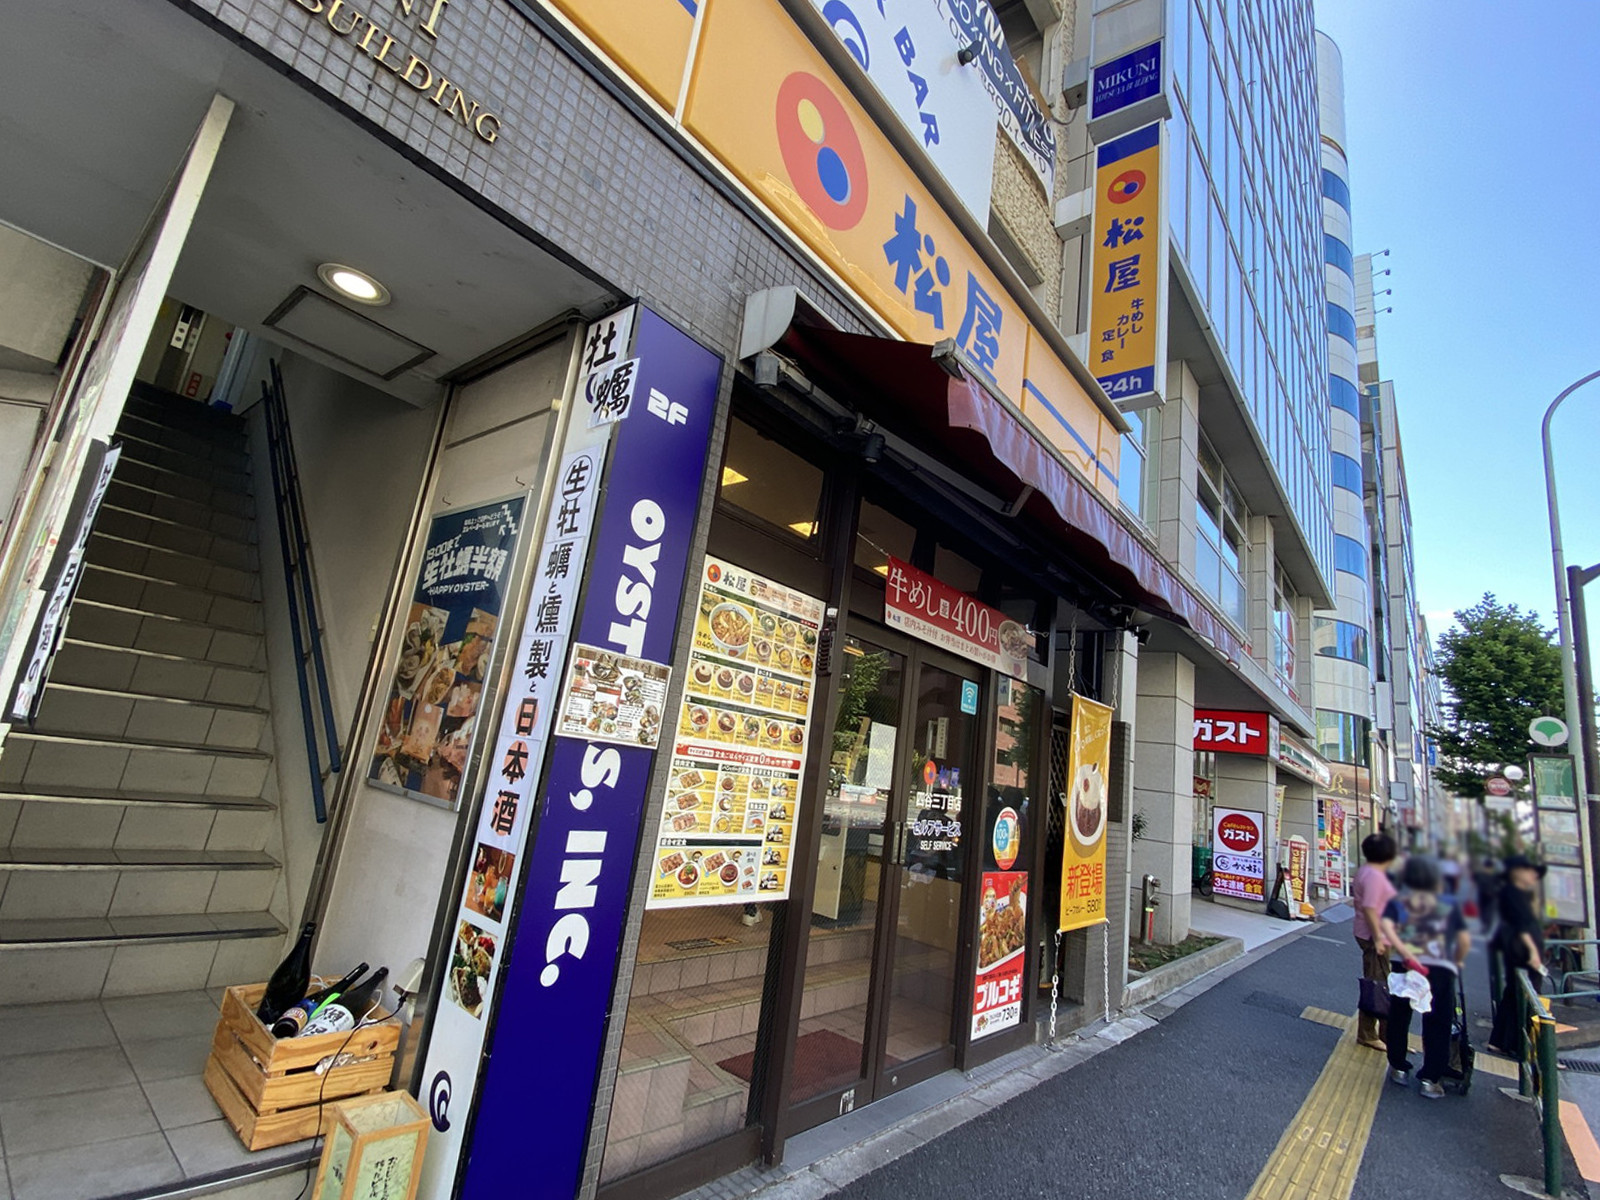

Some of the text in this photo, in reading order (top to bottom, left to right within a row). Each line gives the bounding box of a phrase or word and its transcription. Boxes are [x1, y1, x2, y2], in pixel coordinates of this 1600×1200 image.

[894, 25, 940, 148] BAR
[1097, 57, 1157, 93] MIKUNI
[1103, 216, 1145, 293] 松屋
[882, 193, 1003, 386] 松屋
[1116, 314, 1130, 349] カレー
[1130, 298, 1144, 334] 牛めし
[1101, 375, 1142, 395] 24h
[647, 387, 689, 425] 2F
[722, 571, 748, 594] 松屋
[889, 567, 939, 617] 牛めし
[951, 597, 999, 647] 400円
[1194, 717, 1261, 745] ガスト
[920, 841, 952, 851] SELF SERVICE
[1223, 829, 1256, 843] ガスト
[1066, 863, 1103, 900] 新登場
[539, 829, 609, 987] INC.
